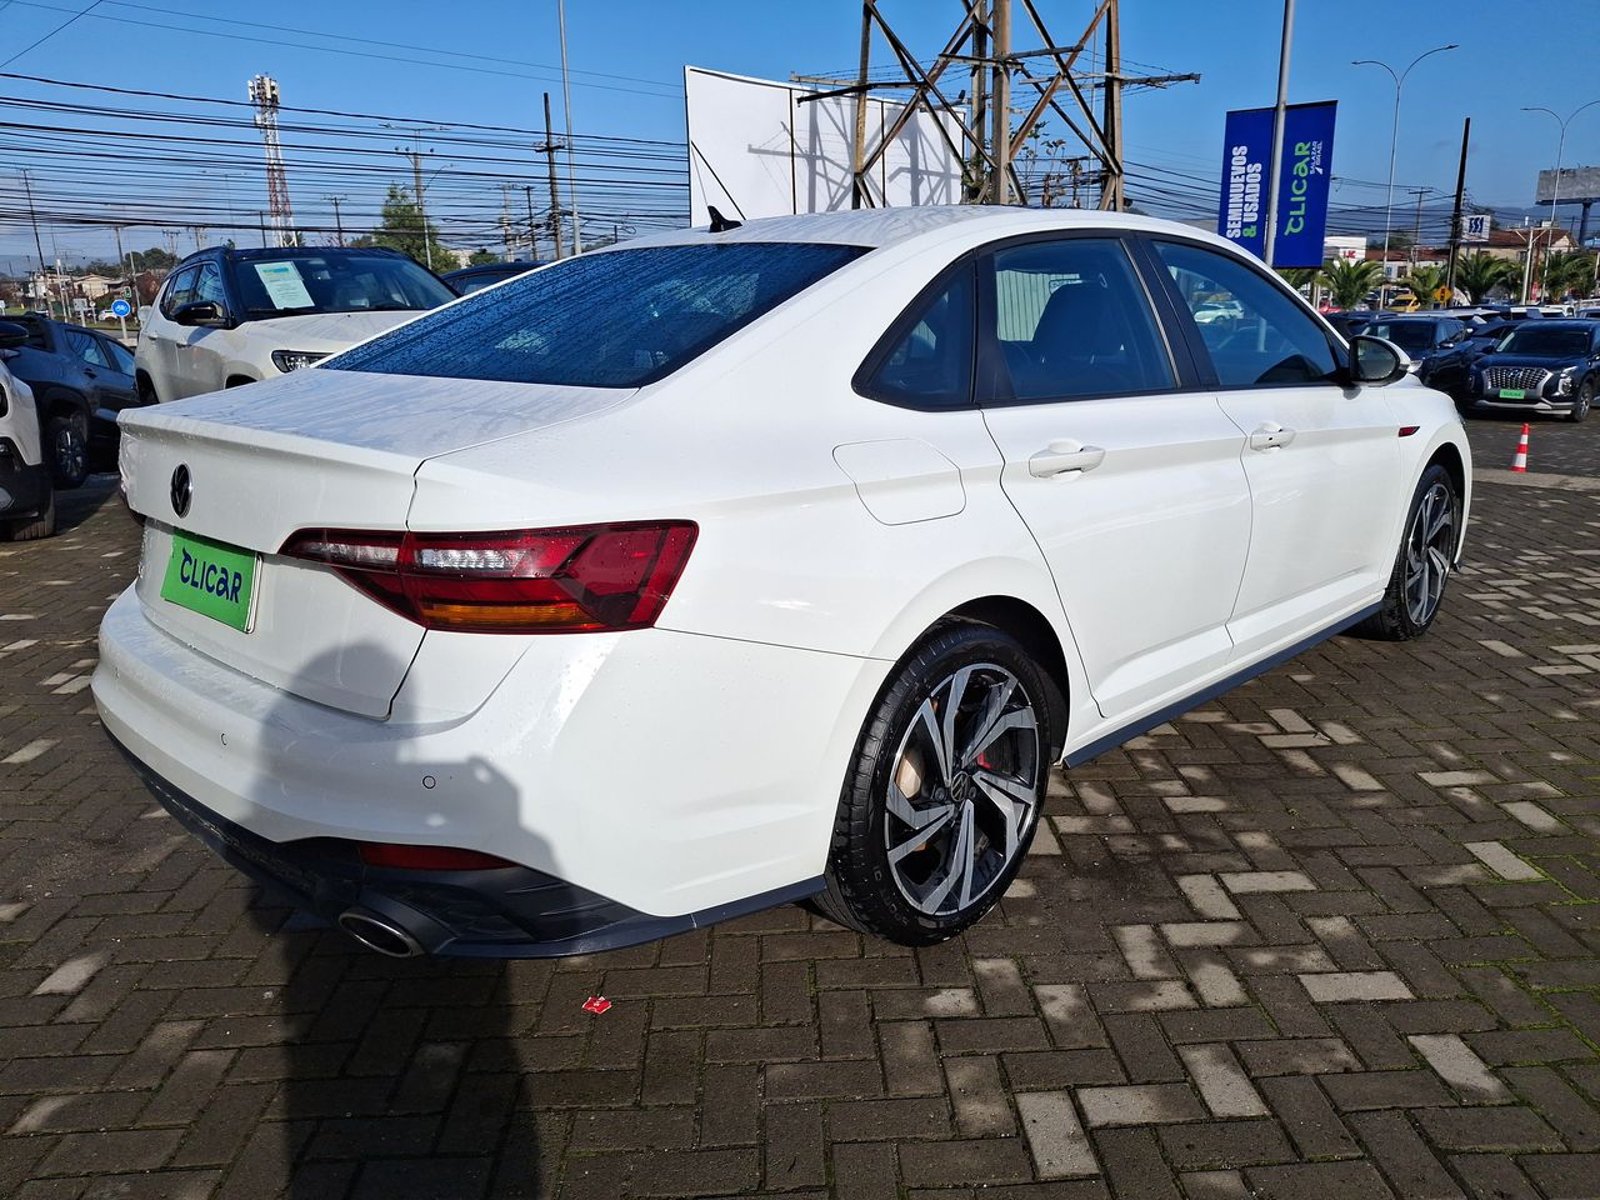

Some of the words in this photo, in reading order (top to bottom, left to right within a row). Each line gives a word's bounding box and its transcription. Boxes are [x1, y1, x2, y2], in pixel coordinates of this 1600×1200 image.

[1226, 145, 1248, 238] SEMINUEVOS
[1243, 163, 1262, 222] USADOS
[1242, 225, 1257, 237] &
